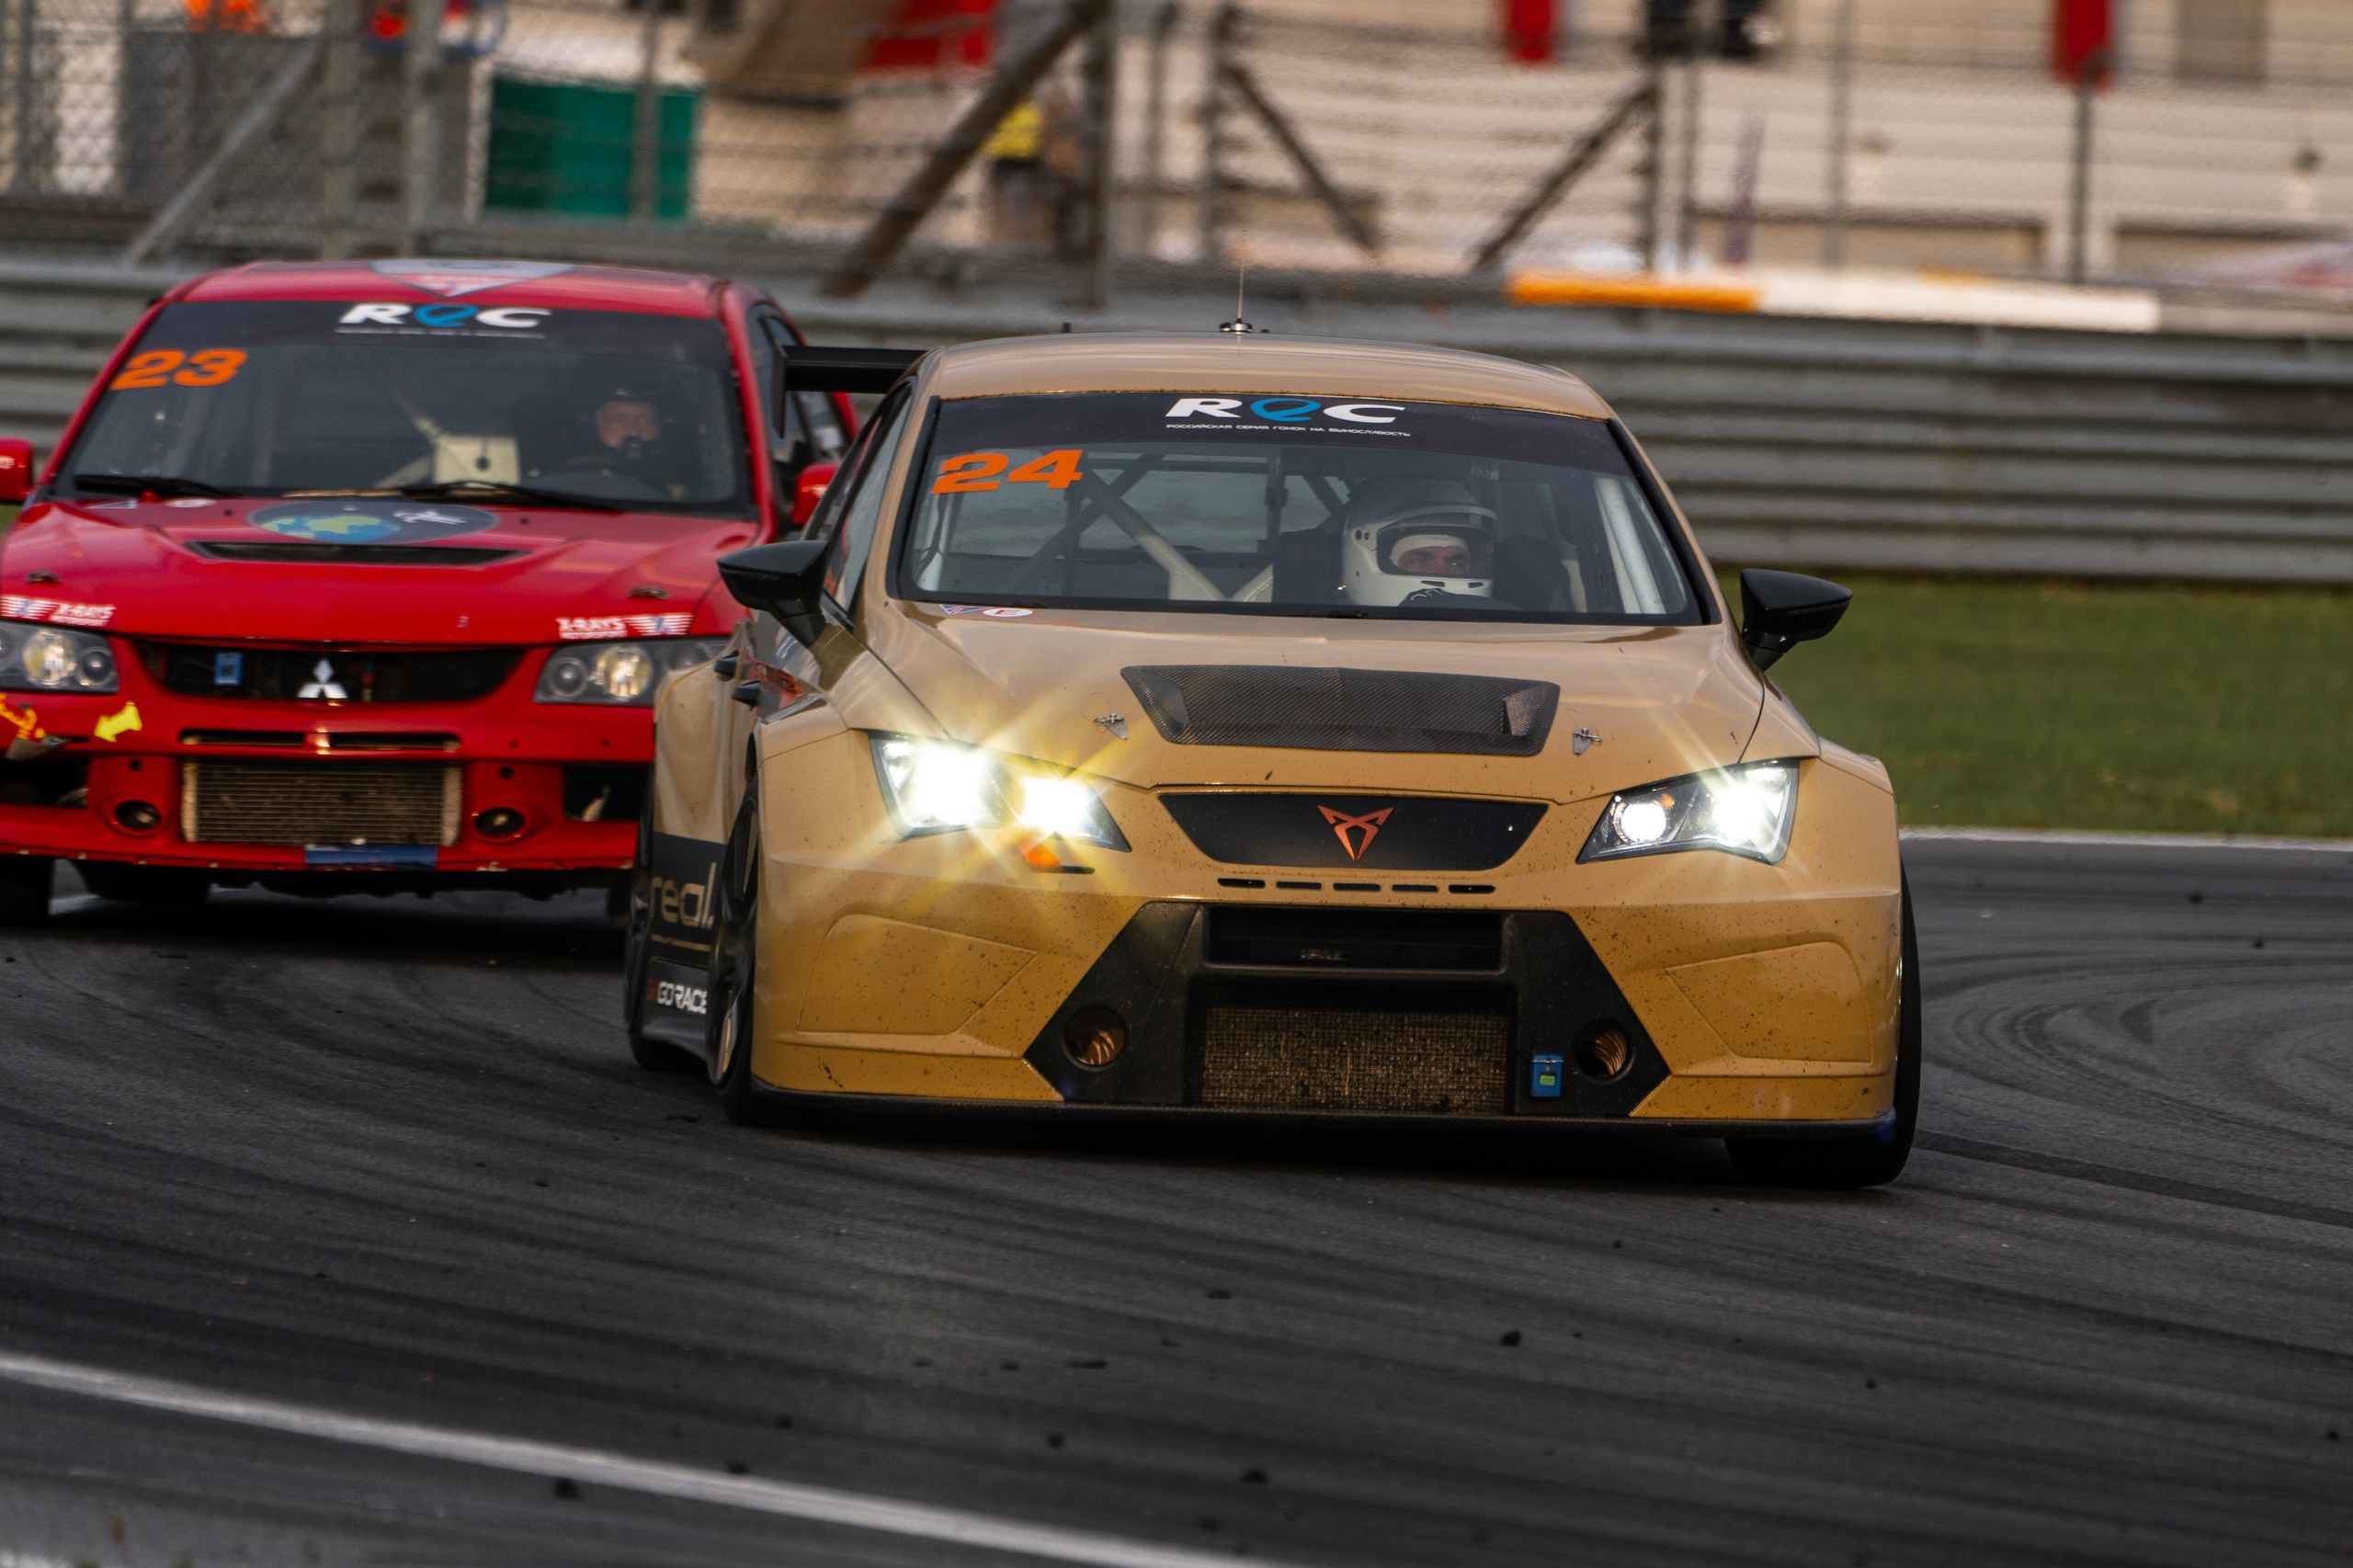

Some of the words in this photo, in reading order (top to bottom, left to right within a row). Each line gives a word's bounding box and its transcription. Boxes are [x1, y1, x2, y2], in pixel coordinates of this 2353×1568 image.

[108, 348, 247, 391] 23
[1328, 427, 1411, 437] ВЫНОСЛИВОСТЬ
[931, 449, 1083, 494] 24
